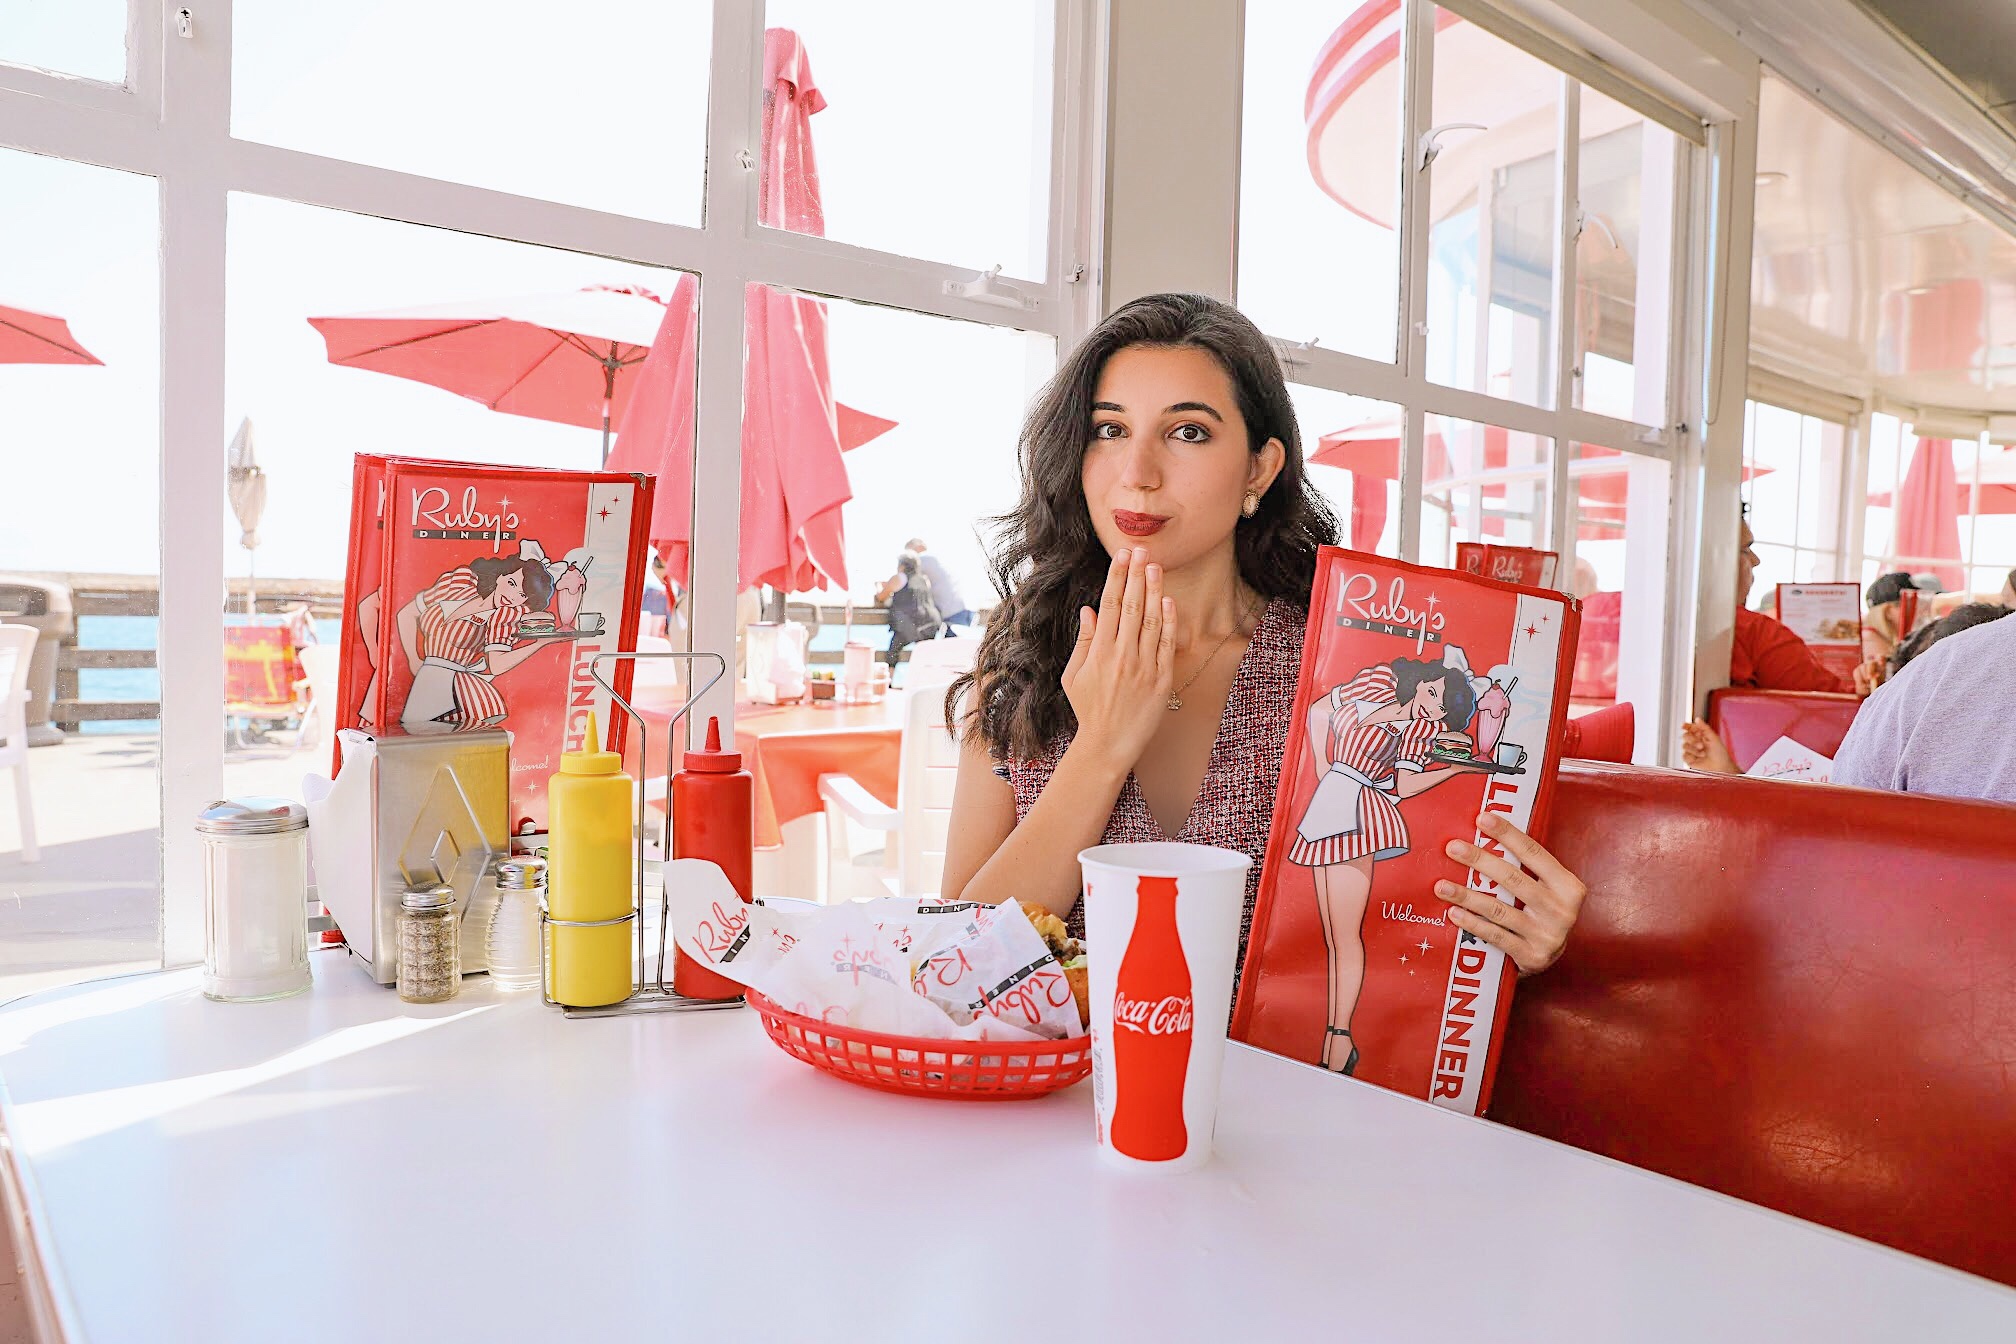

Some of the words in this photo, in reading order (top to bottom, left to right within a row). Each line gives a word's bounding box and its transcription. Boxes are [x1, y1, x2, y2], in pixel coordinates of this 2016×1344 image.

[411, 486, 520, 553] Ruby's
[418, 530, 516, 541] DINER
[1336, 572, 1446, 656] Ruby's
[1342, 618, 1436, 642] DINER
[511, 754, 549, 771] lcome!
[1381, 900, 1448, 928] Welcome!
[1114, 991, 1193, 1035] Coca-Cola
[1432, 948, 1487, 1100] DINNER
